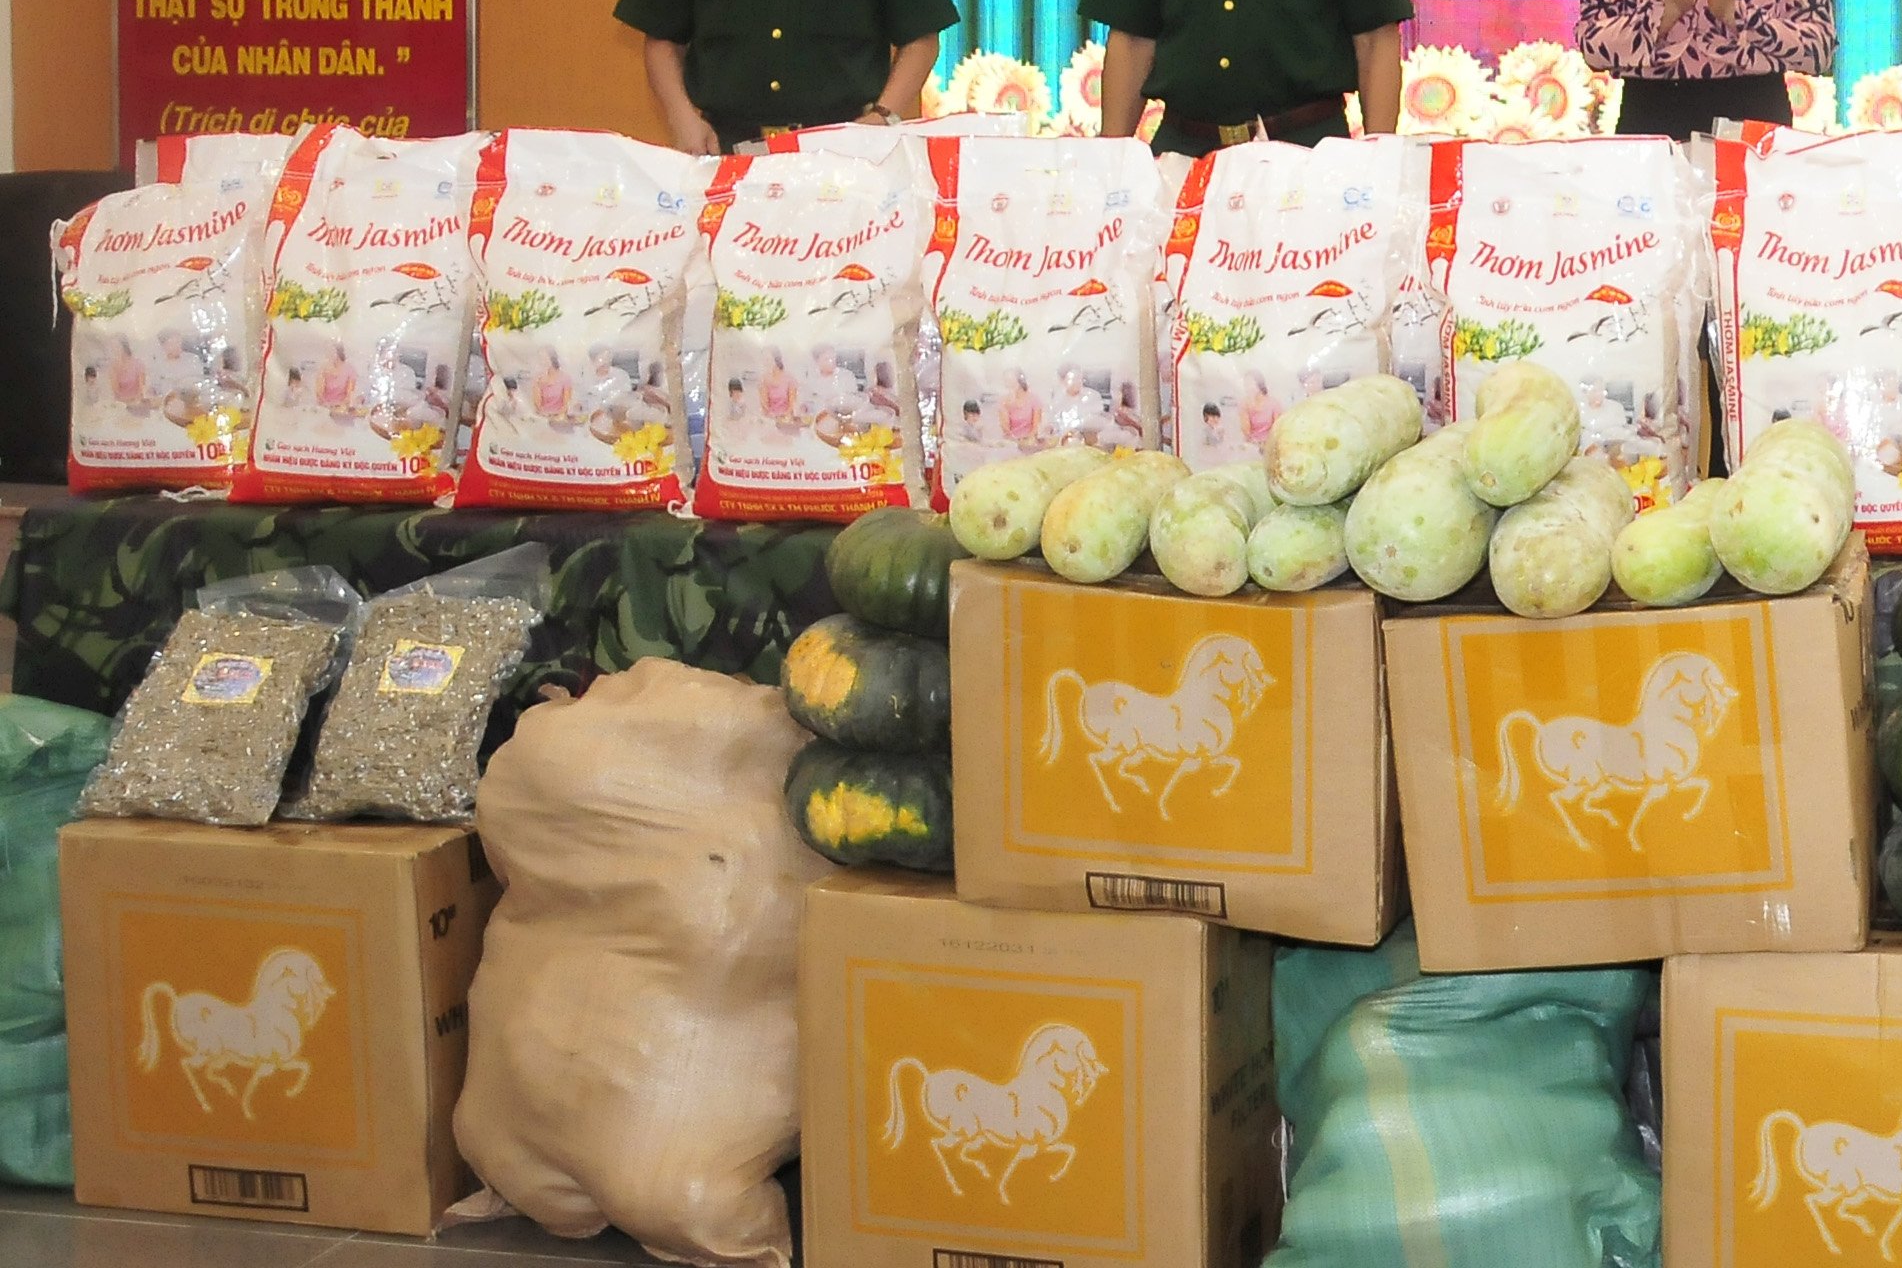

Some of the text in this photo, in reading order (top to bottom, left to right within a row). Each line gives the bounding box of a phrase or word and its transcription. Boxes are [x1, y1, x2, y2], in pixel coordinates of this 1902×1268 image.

[173, 38, 228, 74] CỦA
[238, 40, 310, 75] NHÂN
[1469, 230, 1660, 285] Thơm Jasmine
[1755, 231, 1831, 274] Thơm
